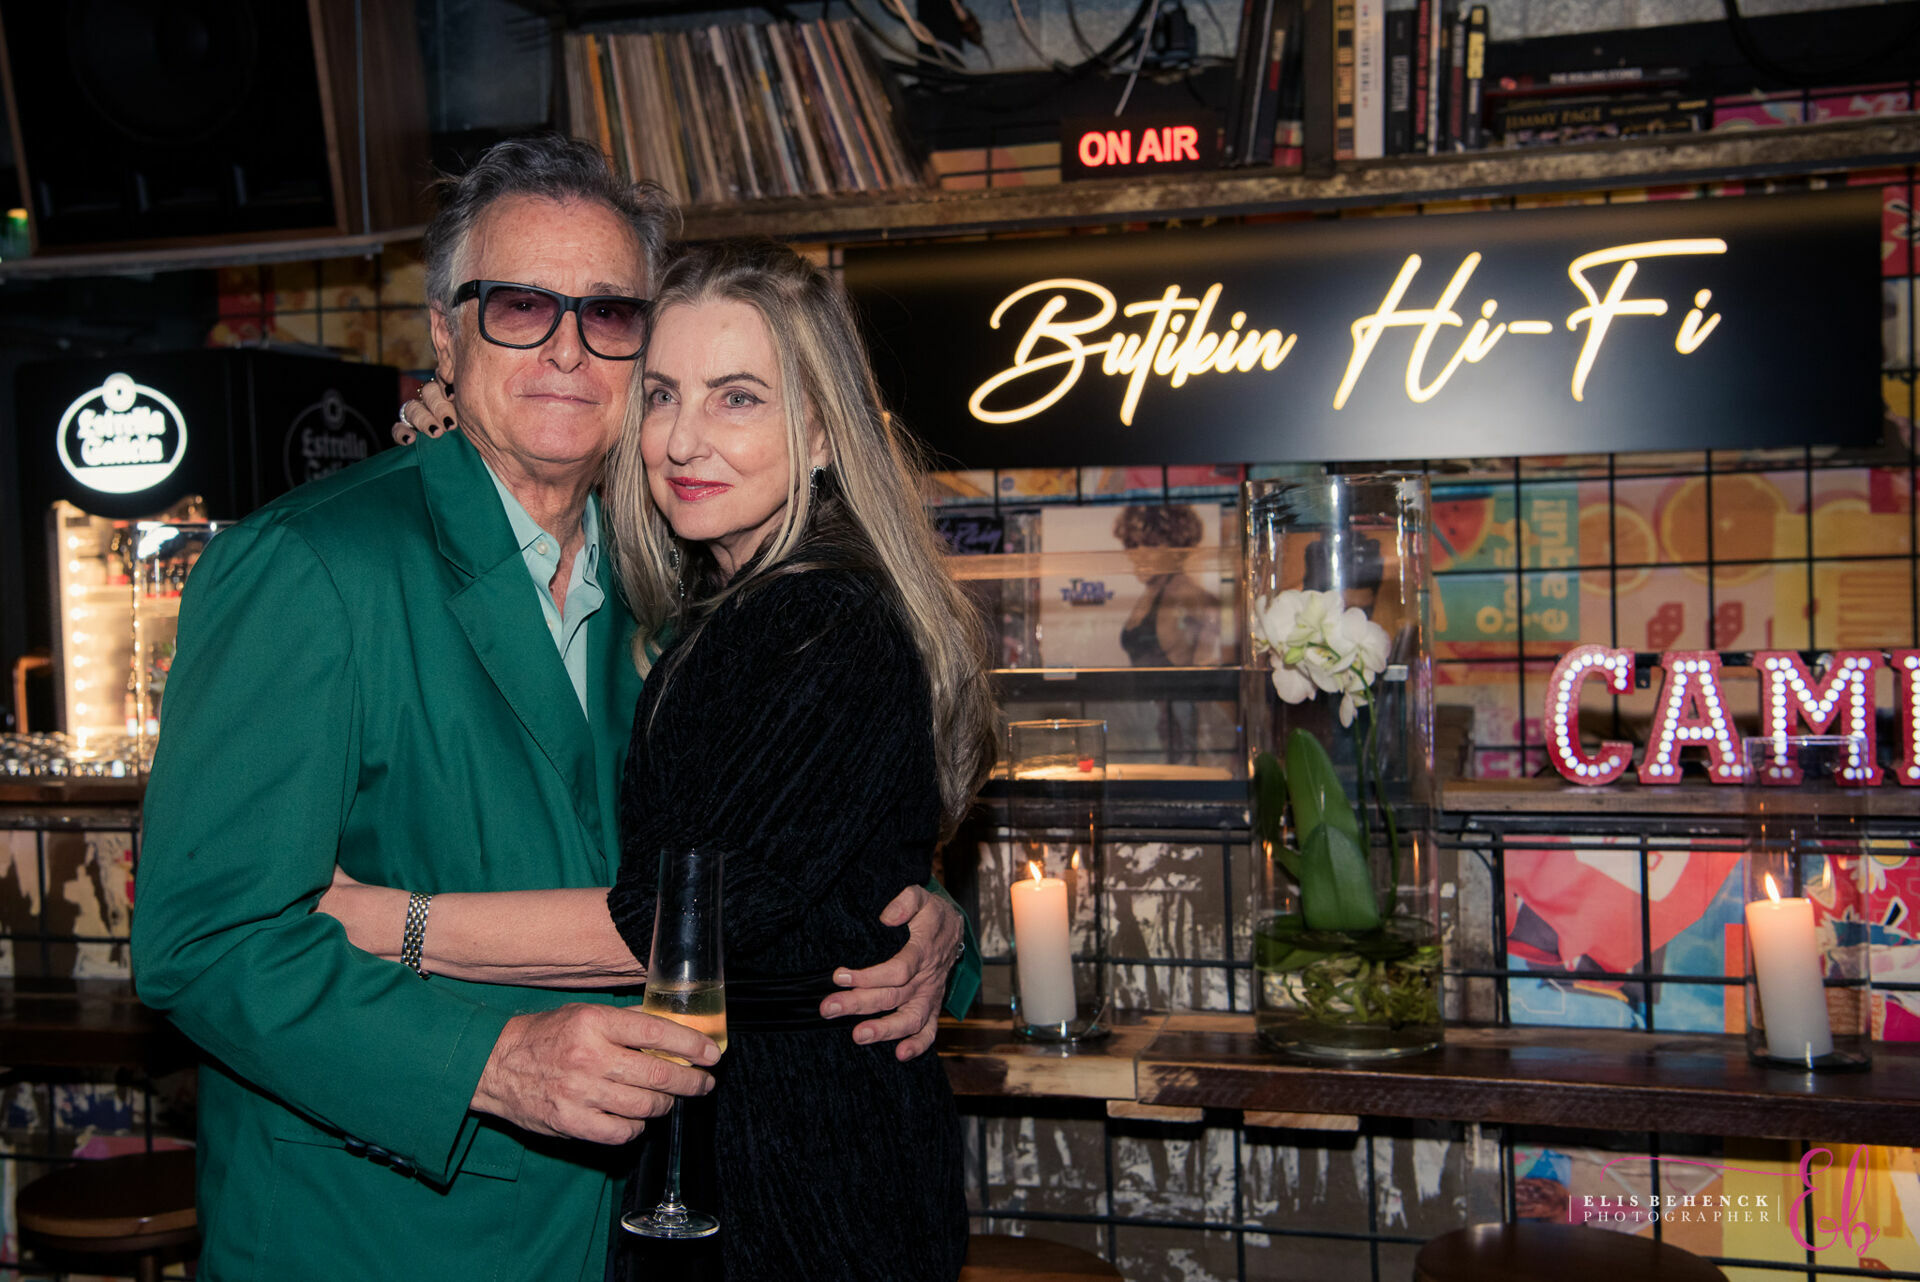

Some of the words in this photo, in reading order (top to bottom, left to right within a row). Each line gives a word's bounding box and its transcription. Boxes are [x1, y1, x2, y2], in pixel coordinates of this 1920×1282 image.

[1078, 130, 1131, 167] ON
[1136, 125, 1200, 163] AIR
[969, 278, 1298, 426] Butikin
[1332, 237, 1727, 411] Hi-Fi
